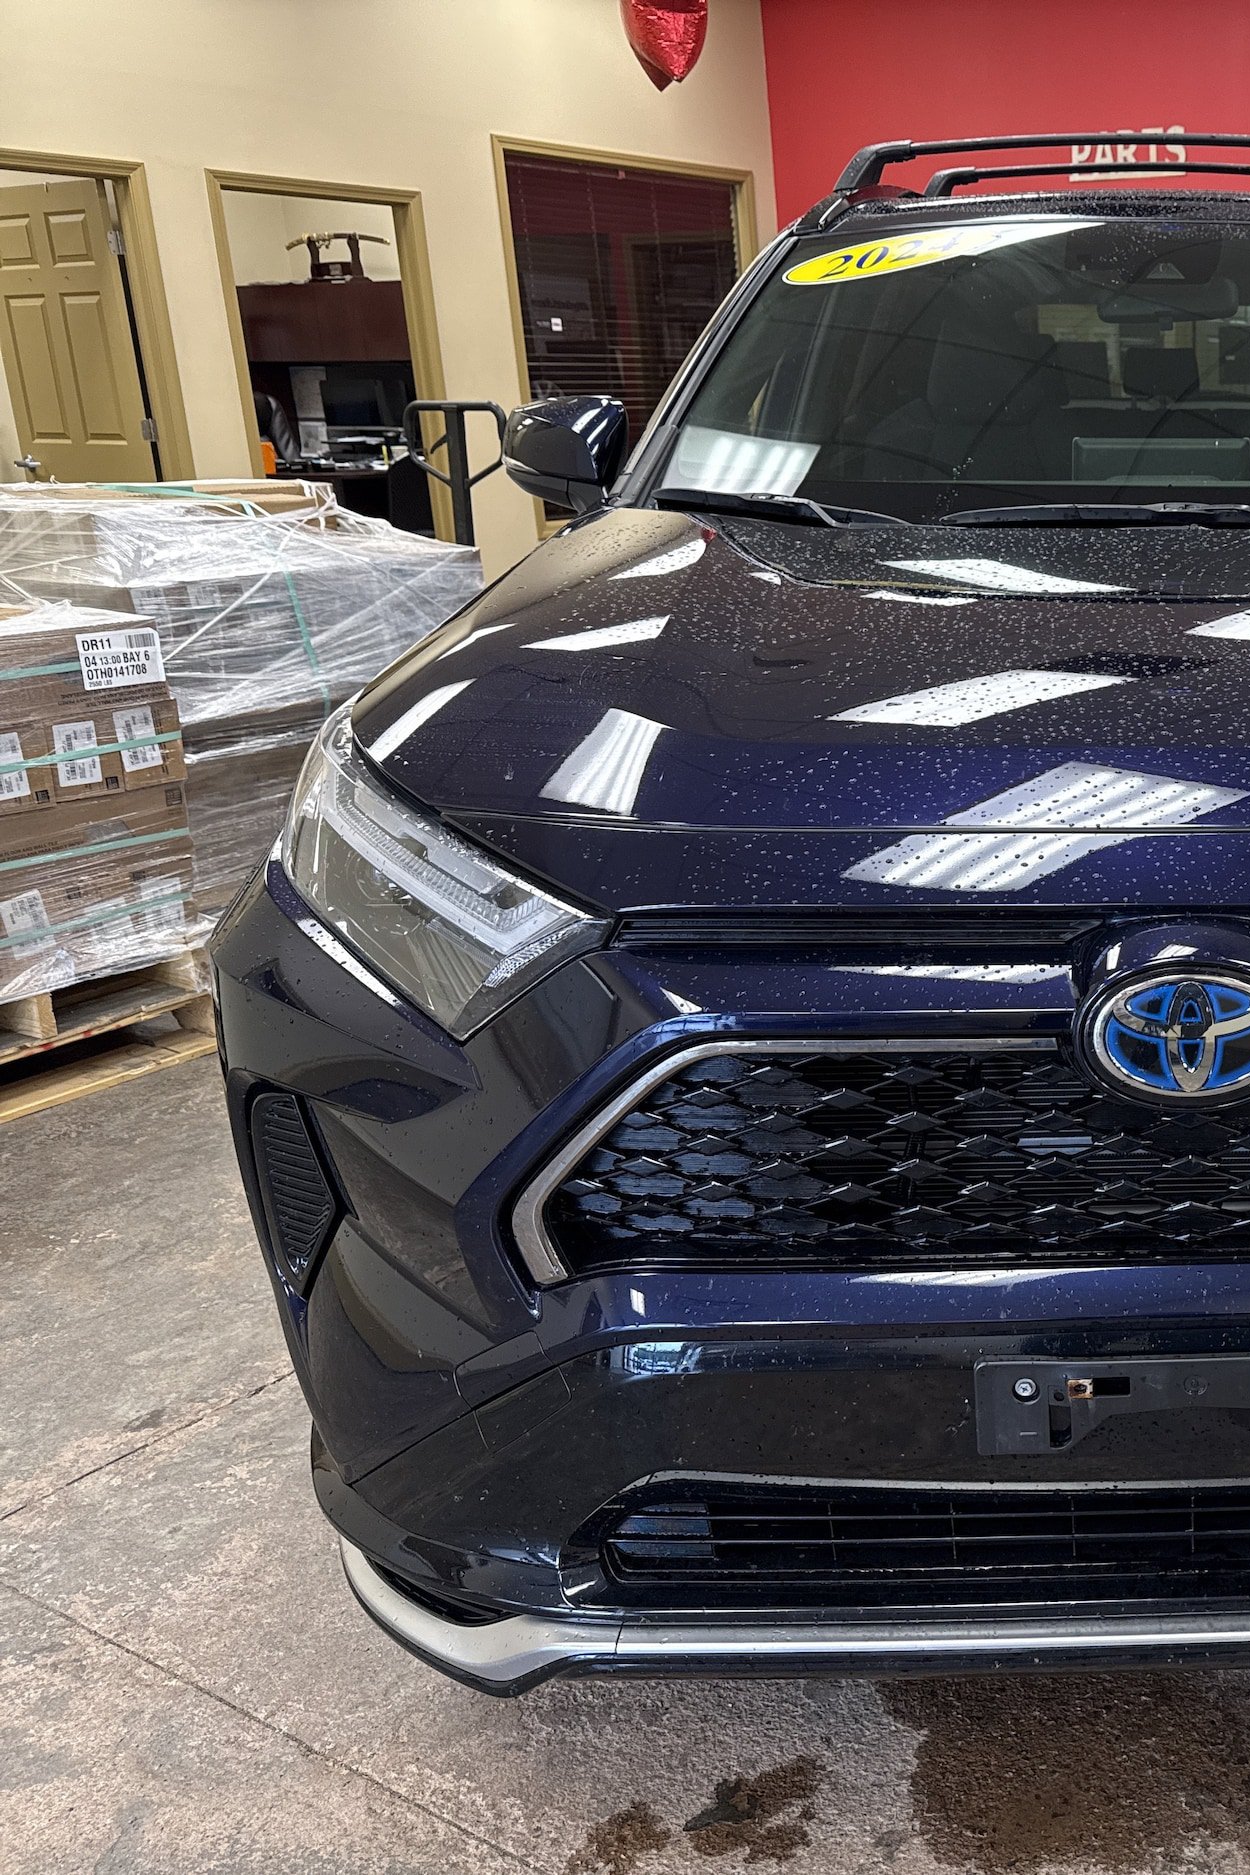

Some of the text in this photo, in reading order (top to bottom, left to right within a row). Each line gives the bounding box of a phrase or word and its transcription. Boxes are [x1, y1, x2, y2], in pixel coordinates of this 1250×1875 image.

[1070, 125, 1187, 175] PARTS
[817, 230, 965, 280] 2024
[82, 638, 112, 652] DR11
[84, 650, 151, 668] 04 13:00 BAY 6
